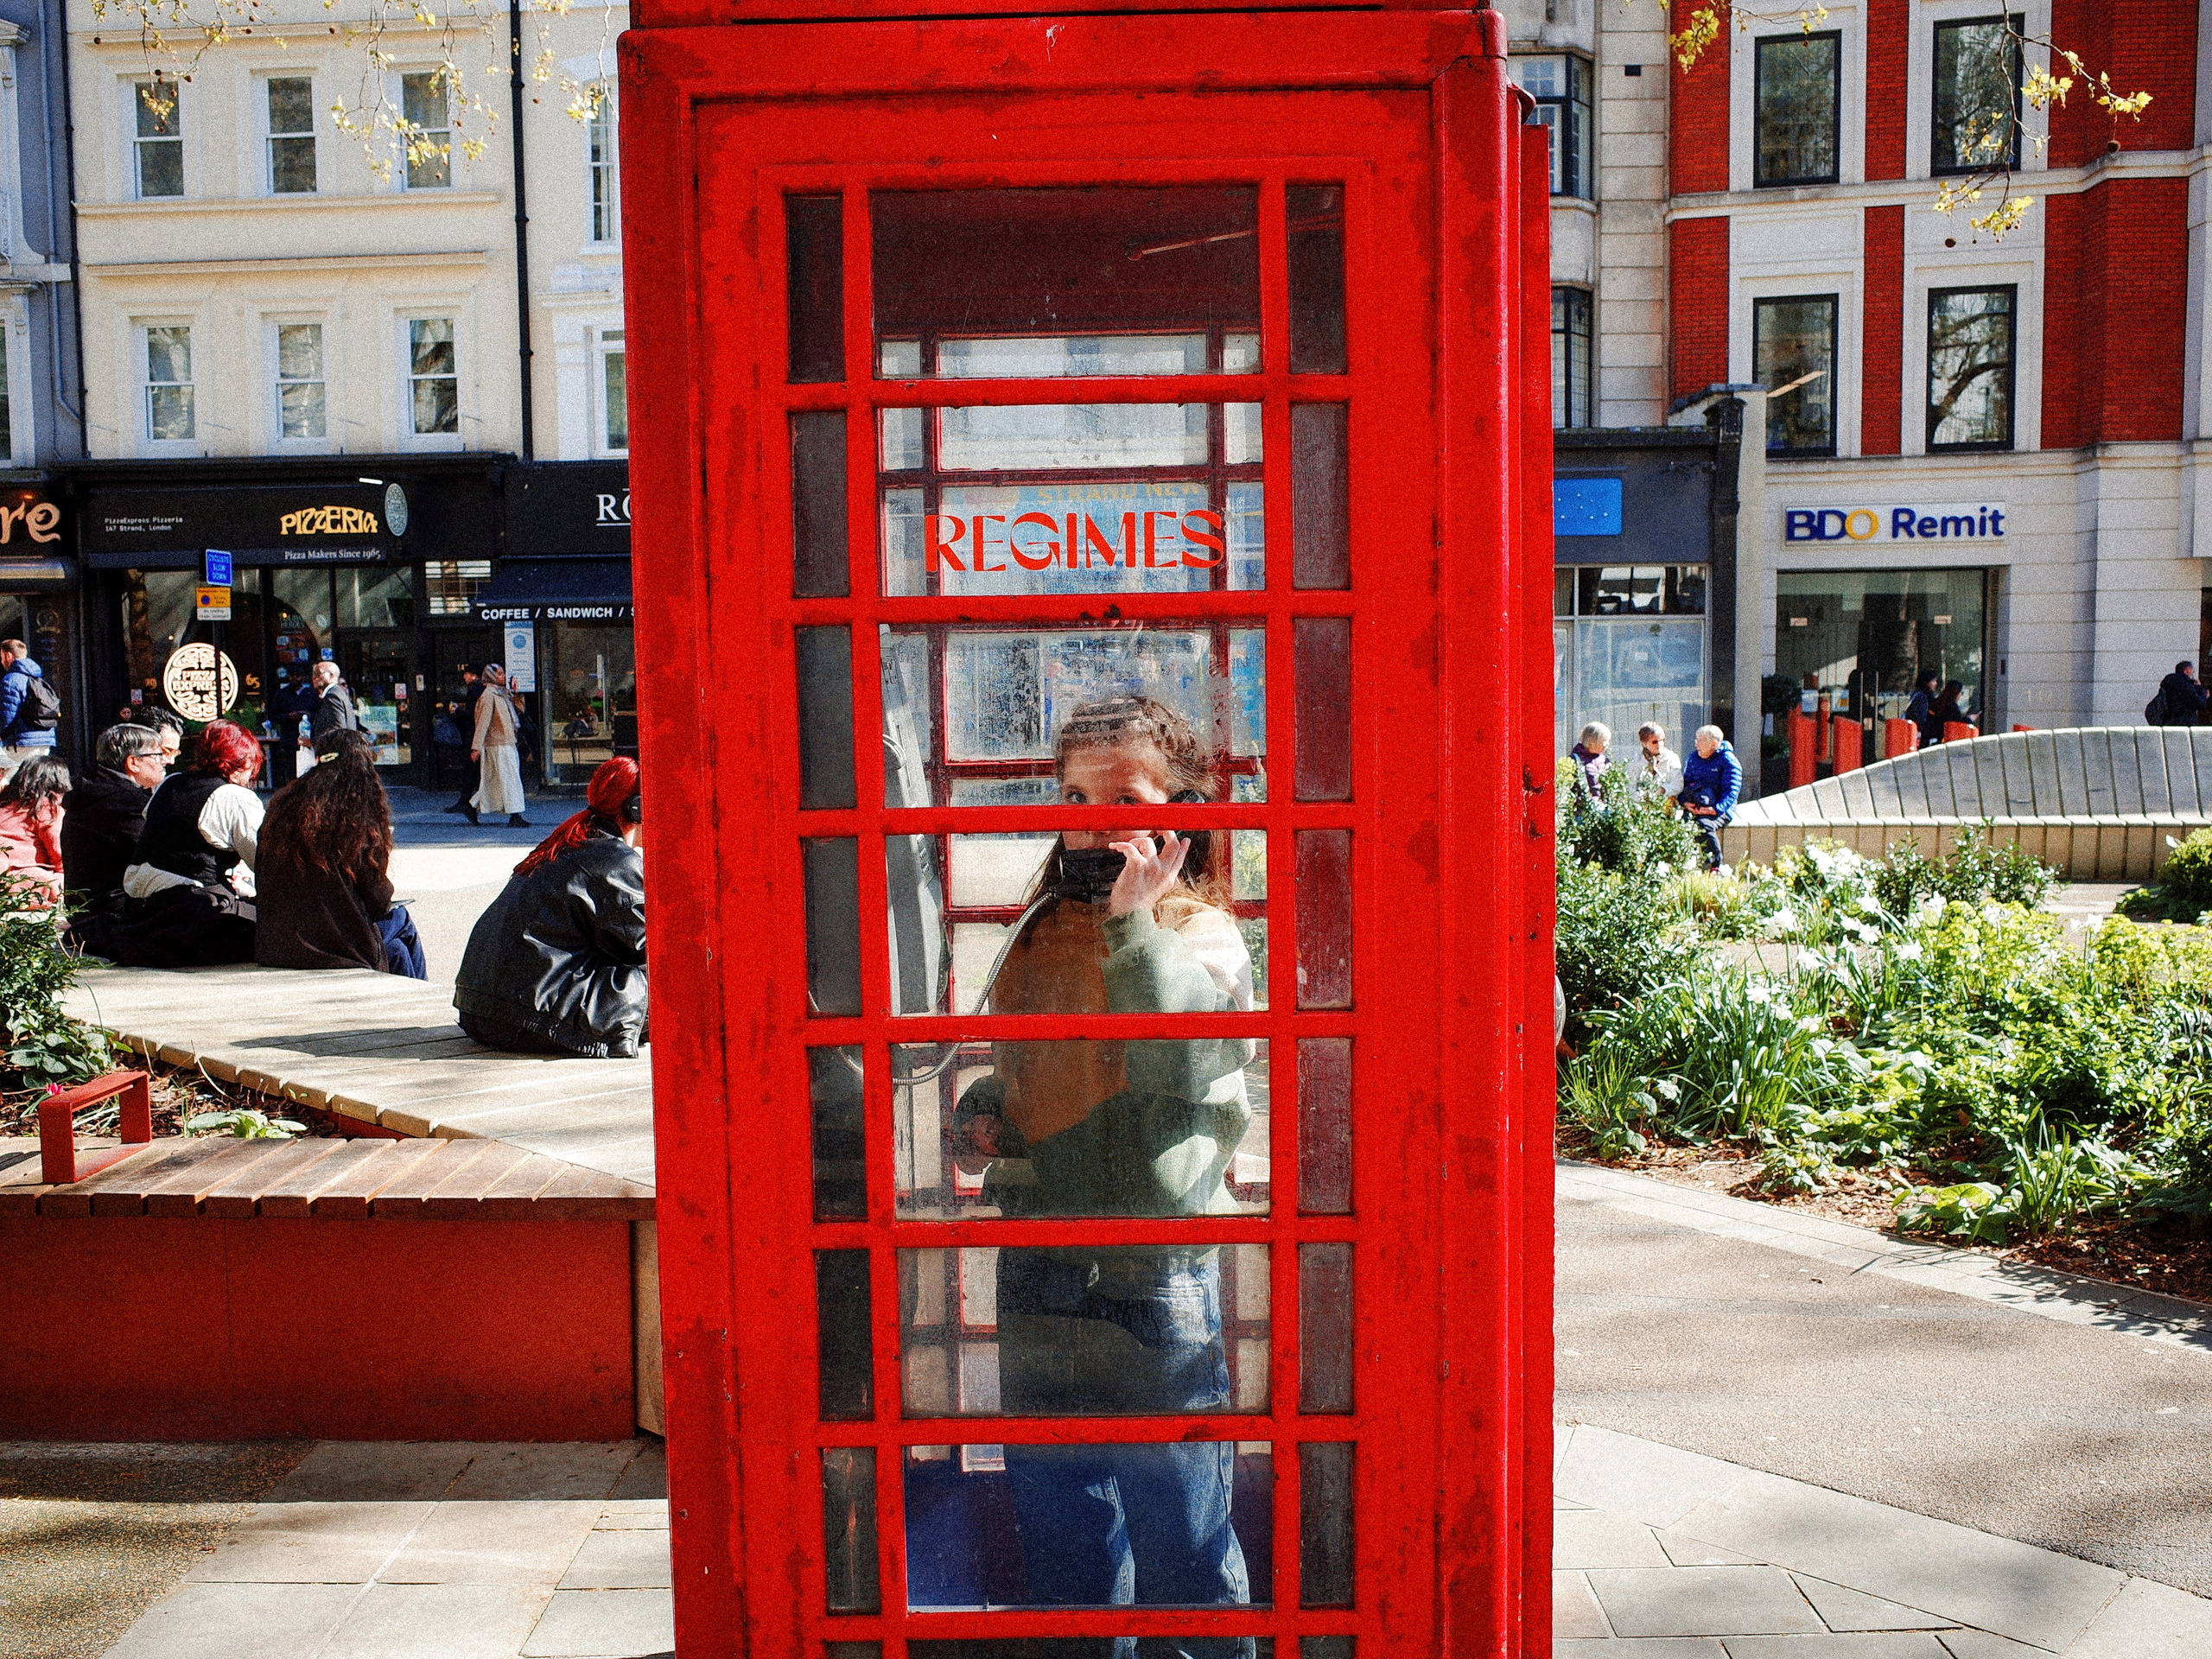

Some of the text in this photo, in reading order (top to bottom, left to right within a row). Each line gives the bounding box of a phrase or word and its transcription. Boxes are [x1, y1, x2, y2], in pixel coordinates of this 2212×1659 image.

[280, 505, 378, 535] PIZZERIA
[1786, 505, 2005, 541] BDO Remit
[284, 548, 381, 560] Pizza Makers Since 1965
[924, 509, 1224, 572] REGIMES
[481, 608, 530, 620] COFFEE
[547, 607, 613, 619] SANDWICH
